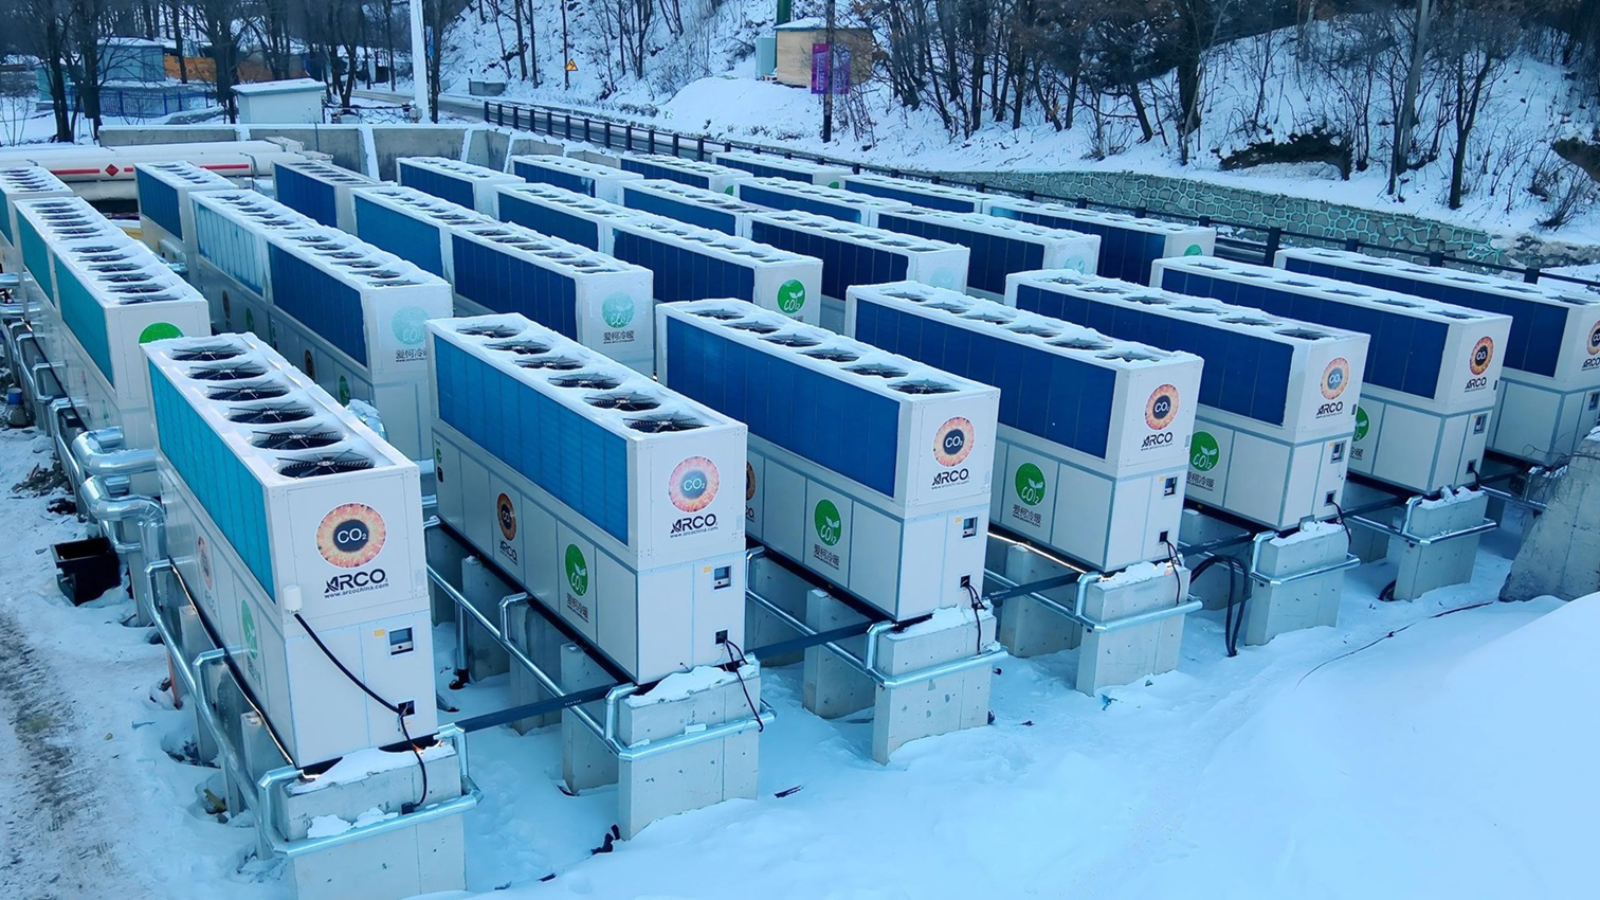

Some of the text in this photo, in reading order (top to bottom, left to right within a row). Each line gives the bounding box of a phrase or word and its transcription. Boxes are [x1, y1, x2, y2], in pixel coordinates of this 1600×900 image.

[1316, 401, 1344, 416] ARCO
[1141, 432, 1173, 448] ARCO
[683, 478, 706, 491] CO2
[337, 528, 367, 544] CO2
[324, 583, 389, 599] www.arcochina.com
